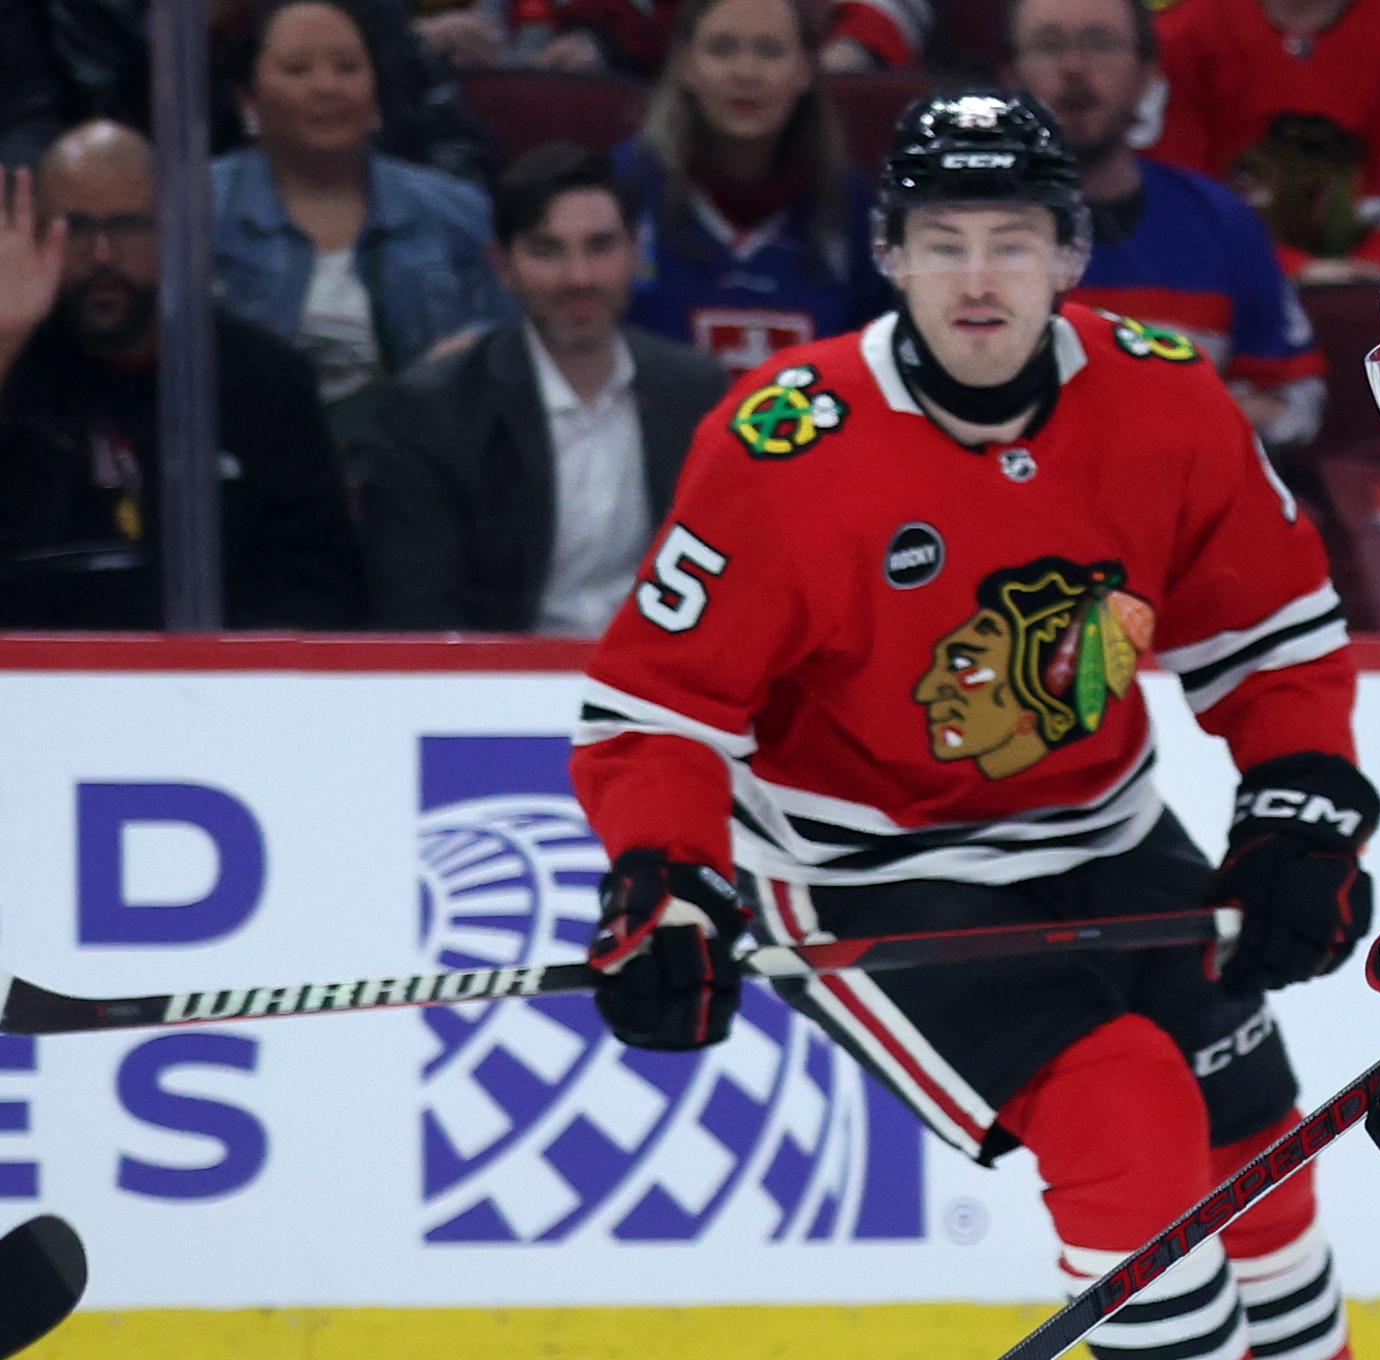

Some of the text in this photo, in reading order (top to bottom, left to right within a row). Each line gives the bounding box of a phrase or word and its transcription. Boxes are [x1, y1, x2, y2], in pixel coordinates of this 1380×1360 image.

[942, 153, 1016, 169] CCM
[637, 522, 731, 633] 5
[163, 966, 548, 1024] WARRIOR
[1103, 1087, 1370, 1314] JETSPEED
